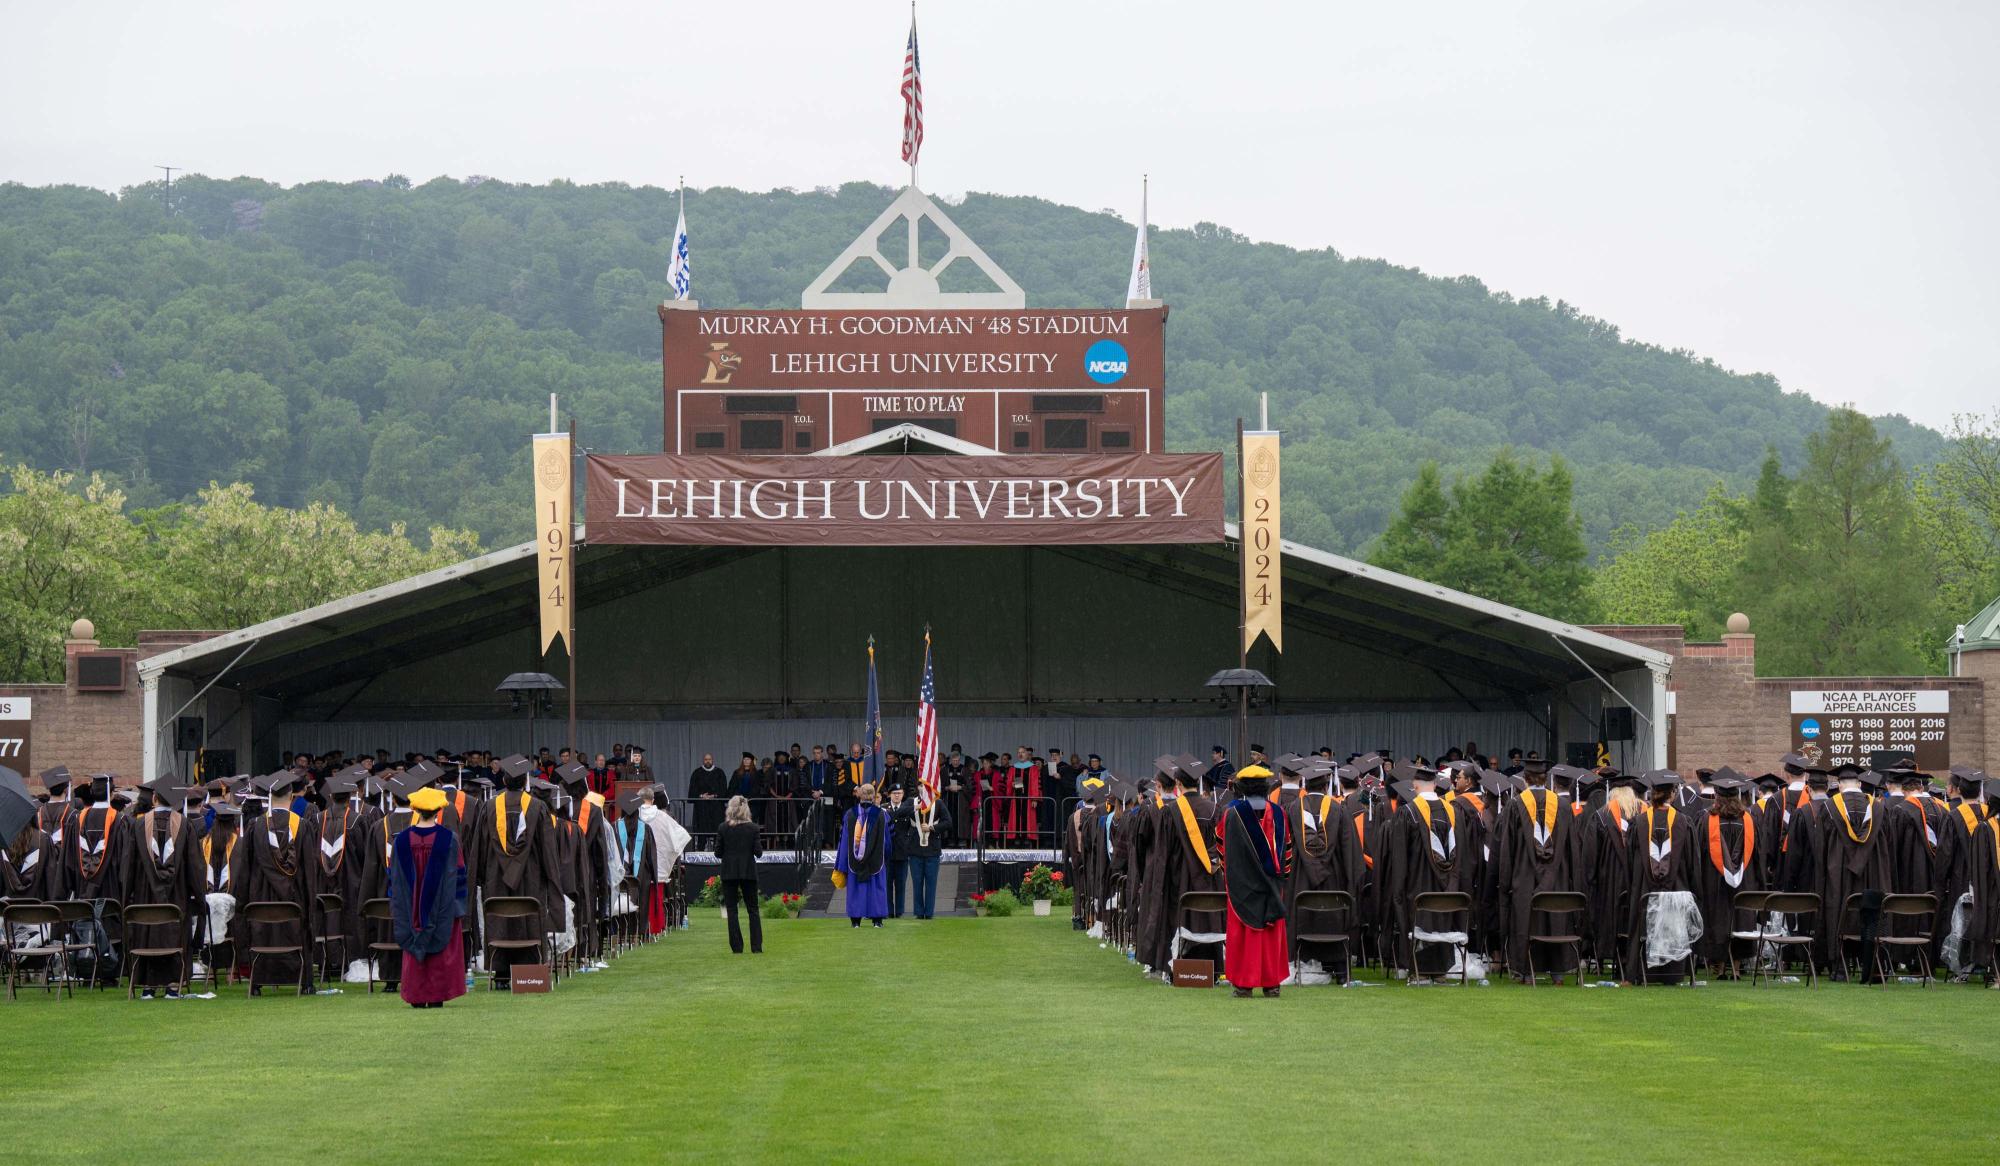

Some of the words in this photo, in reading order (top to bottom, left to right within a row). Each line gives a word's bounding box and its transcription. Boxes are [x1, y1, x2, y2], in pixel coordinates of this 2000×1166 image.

[699, 316, 804, 335] MURRAY
[808, 316, 833, 335] H.
[840, 316, 974, 335] GOODMAN
[1017, 316, 1129, 334] STADIUM
[770, 353, 880, 373] LEHIGH
[889, 353, 1058, 373] UNIVERSITY
[1088, 361, 1127, 374] NCAA
[863, 396, 901, 412] TIME
[903, 396, 926, 412] TO
[929, 396, 966, 412] PLAY
[613, 478, 836, 520] LEHIGH
[854, 477, 1196, 520] UNIVERSITY
[547, 500, 565, 607] 1974
[1254, 498, 1272, 606] 2024
[1822, 692, 1858, 702] NCAA
[1863, 692, 1917, 702] PLAYOFF
[1823, 702, 1917, 712] APPEARANCES
[1829, 719, 1853, 728] 1973
[1859, 719, 1884, 728] 1980
[1890, 719, 1915, 728] 2001
[1920, 719, 1946, 728] 2016
[1829, 732, 1853, 741] 1975
[1859, 732, 1884, 741] 1998
[1890, 732, 1917, 741] 2004
[1920, 732, 1945, 741] 2017
[1830, 744, 1853, 754] 1977
[1830, 757, 1854, 767] 1979
